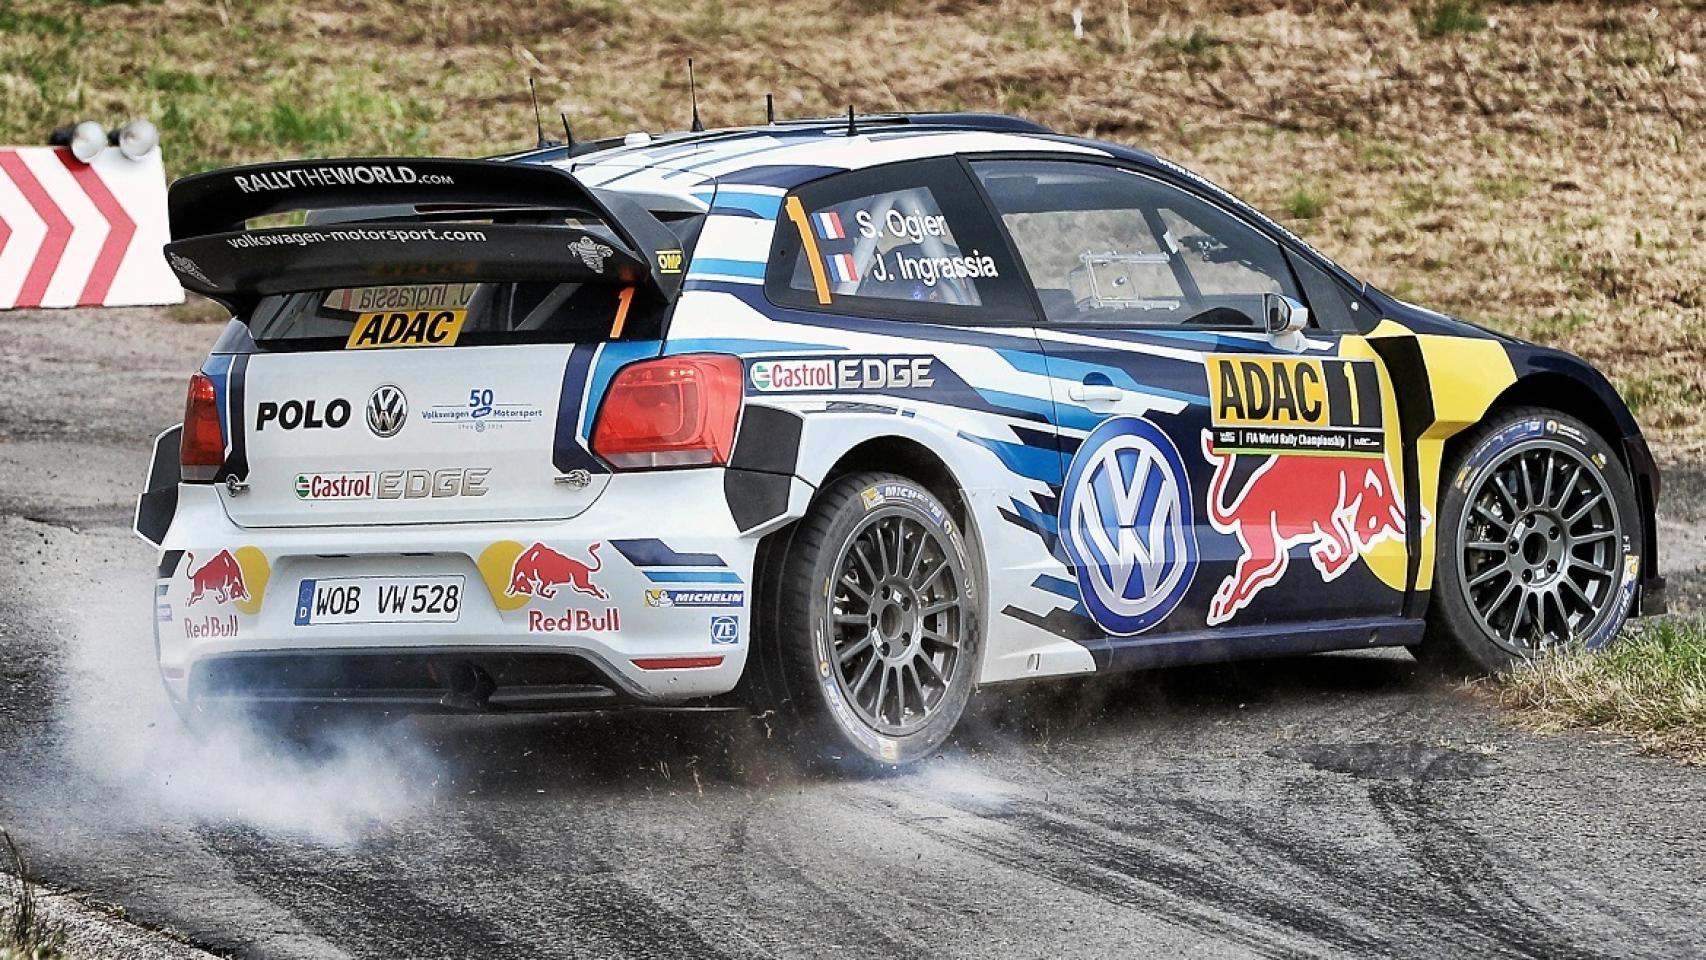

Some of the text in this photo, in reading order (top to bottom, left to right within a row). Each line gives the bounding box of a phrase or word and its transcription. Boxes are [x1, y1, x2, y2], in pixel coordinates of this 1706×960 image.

[226, 228, 487, 249] volkswagen-motorsport.com
[856, 209, 947, 243] S. Ogier
[657, 254, 682, 270] OMP
[785, 196, 832, 304] 1
[874, 250, 998, 286] J. Ingrassia
[609, 287, 635, 338] 1
[355, 311, 456, 345] ADAC
[772, 358, 935, 389] Castrol EDGE
[469, 388, 494, 407] 50
[1219, 359, 1361, 425] ADAC 1
[256, 398, 351, 431] POLO
[421, 410, 469, 420] Volkswagen
[493, 408, 543, 419] Motorsport
[1246, 431, 1258, 444] FIA
[1259, 432, 1279, 445] World
[1280, 433, 1298, 447] Rally
[1299, 434, 1345, 448] Championship
[310, 467, 492, 499] Castrol EDGE
[315, 584, 460, 616] WOB VW 528
[675, 592, 742, 602] MICHELIN
[184, 614, 238, 638] Red Bull
[299, 607, 307, 618] D
[529, 608, 619, 632] Red Bull
[713, 620, 737, 640] ZF
